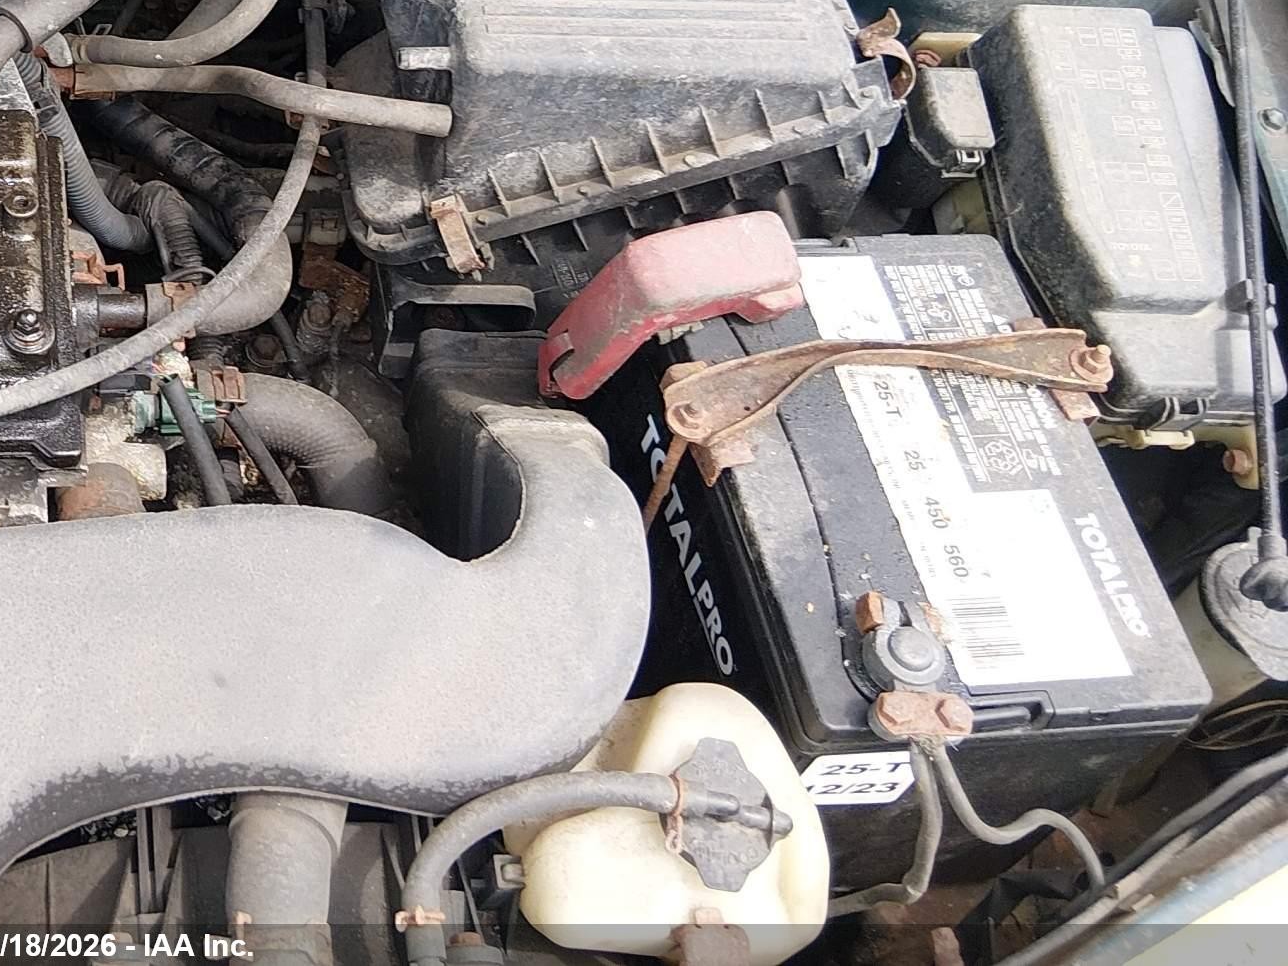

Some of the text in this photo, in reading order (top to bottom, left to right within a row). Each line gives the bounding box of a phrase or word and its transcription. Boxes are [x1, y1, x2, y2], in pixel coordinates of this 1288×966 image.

[641, 413, 734, 676] TOTALPRO
[873, 380, 903, 418] 25-T
[904, 450, 926, 471] 25
[925, 496, 951, 529] 450
[944, 544, 969, 578] 560
[1073, 512, 1149, 637] TOTALPRO
